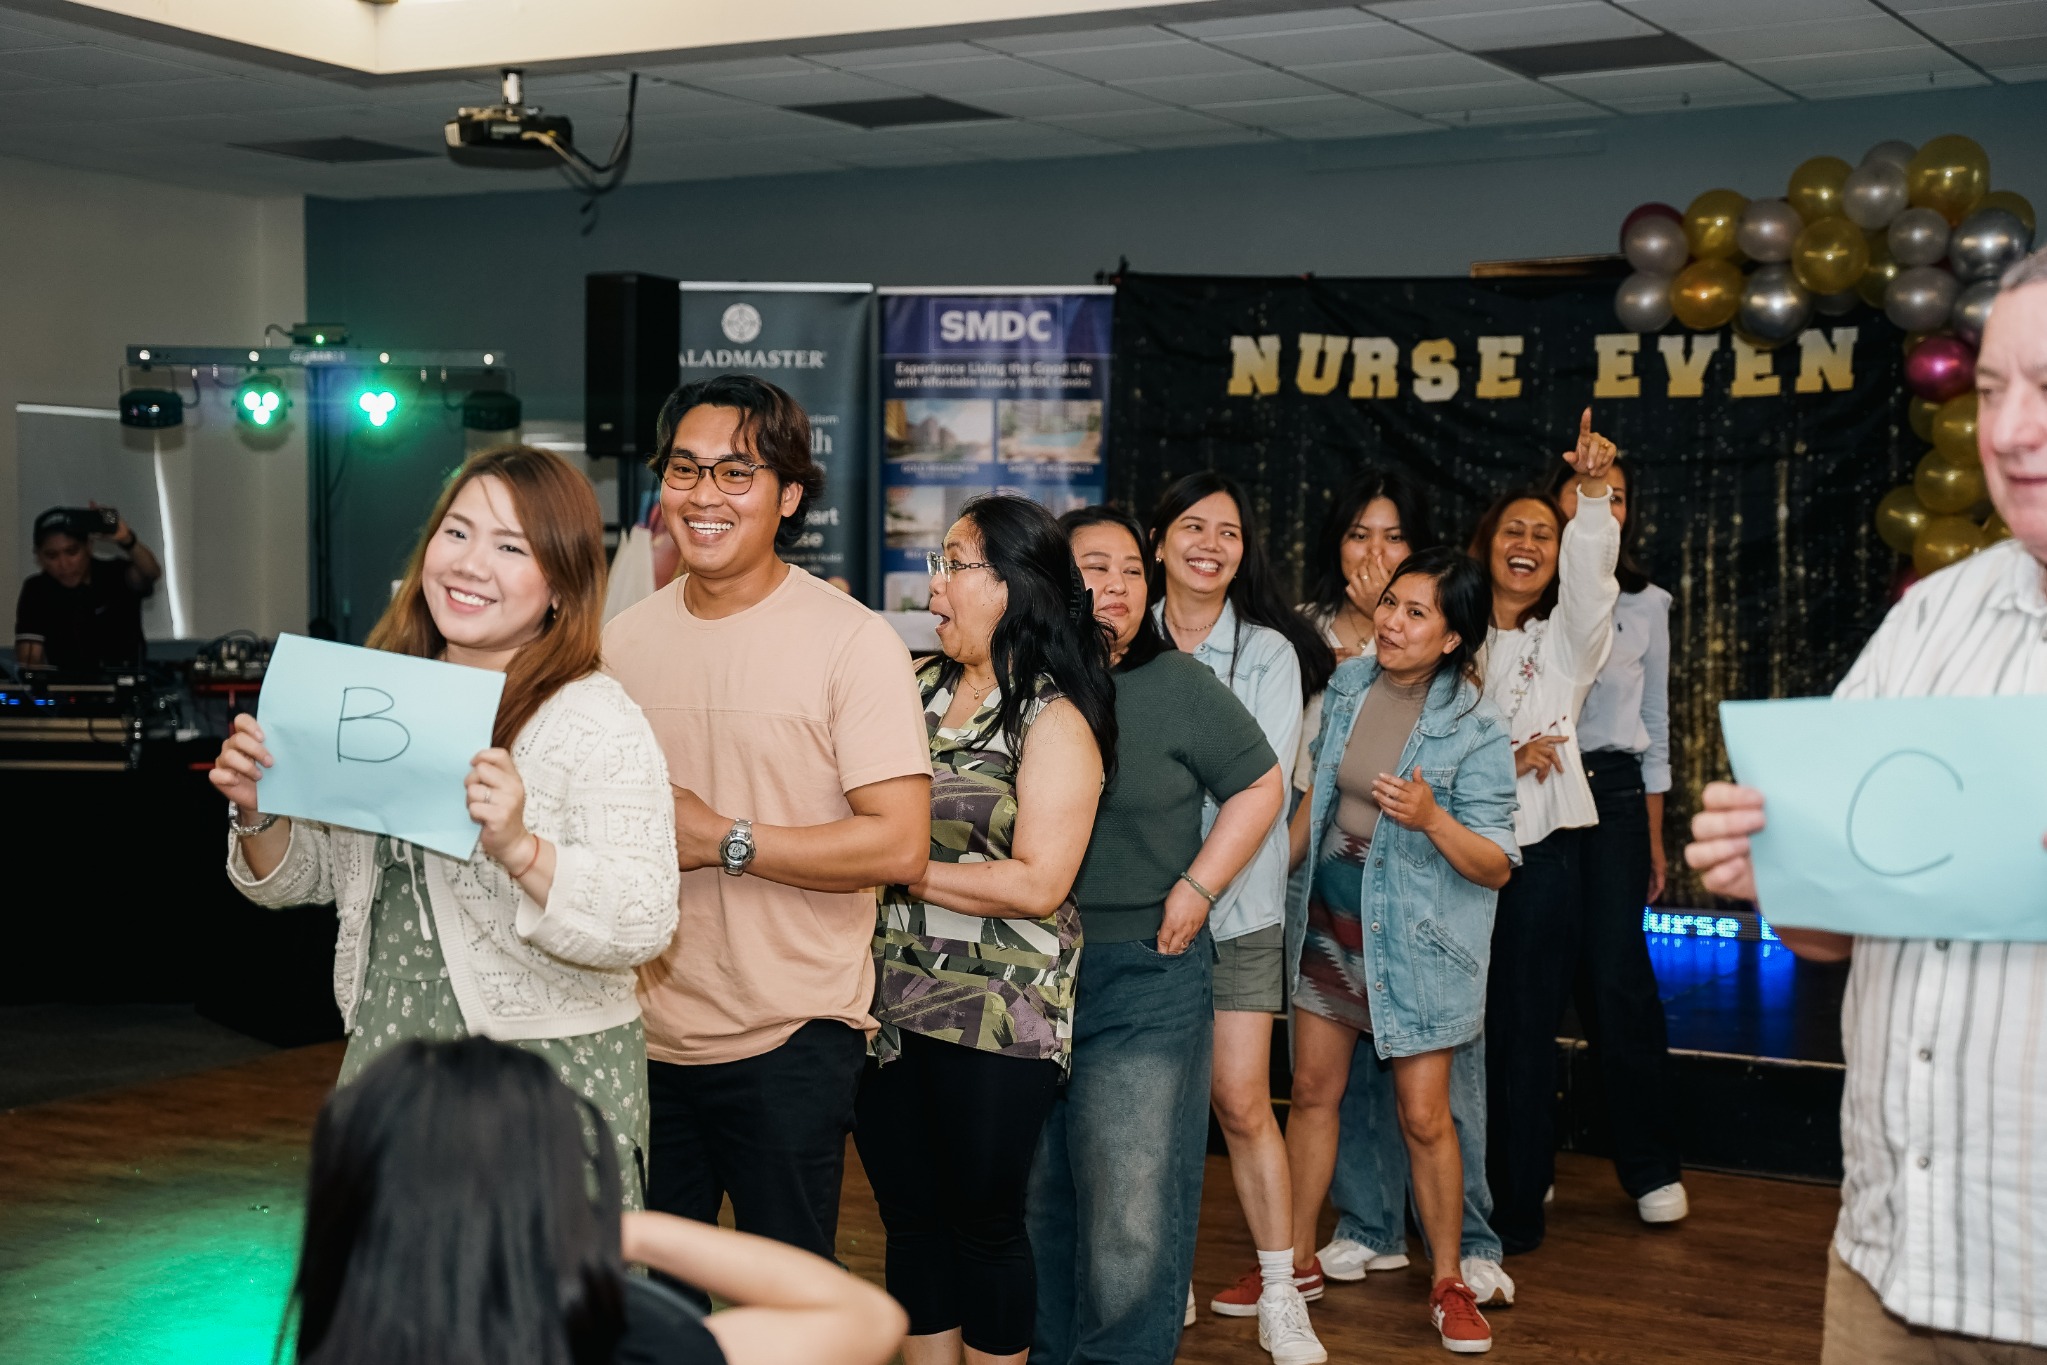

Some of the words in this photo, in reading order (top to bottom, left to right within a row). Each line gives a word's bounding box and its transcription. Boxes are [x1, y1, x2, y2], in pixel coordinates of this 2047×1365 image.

[679, 349, 825, 368] ALADMASTER
[940, 310, 1052, 342] SMDC
[1227, 332, 1525, 402] NURSE
[1593, 326, 1859, 398] EVEN
[337, 686, 411, 763] B
[1846, 748, 1964, 877] C
